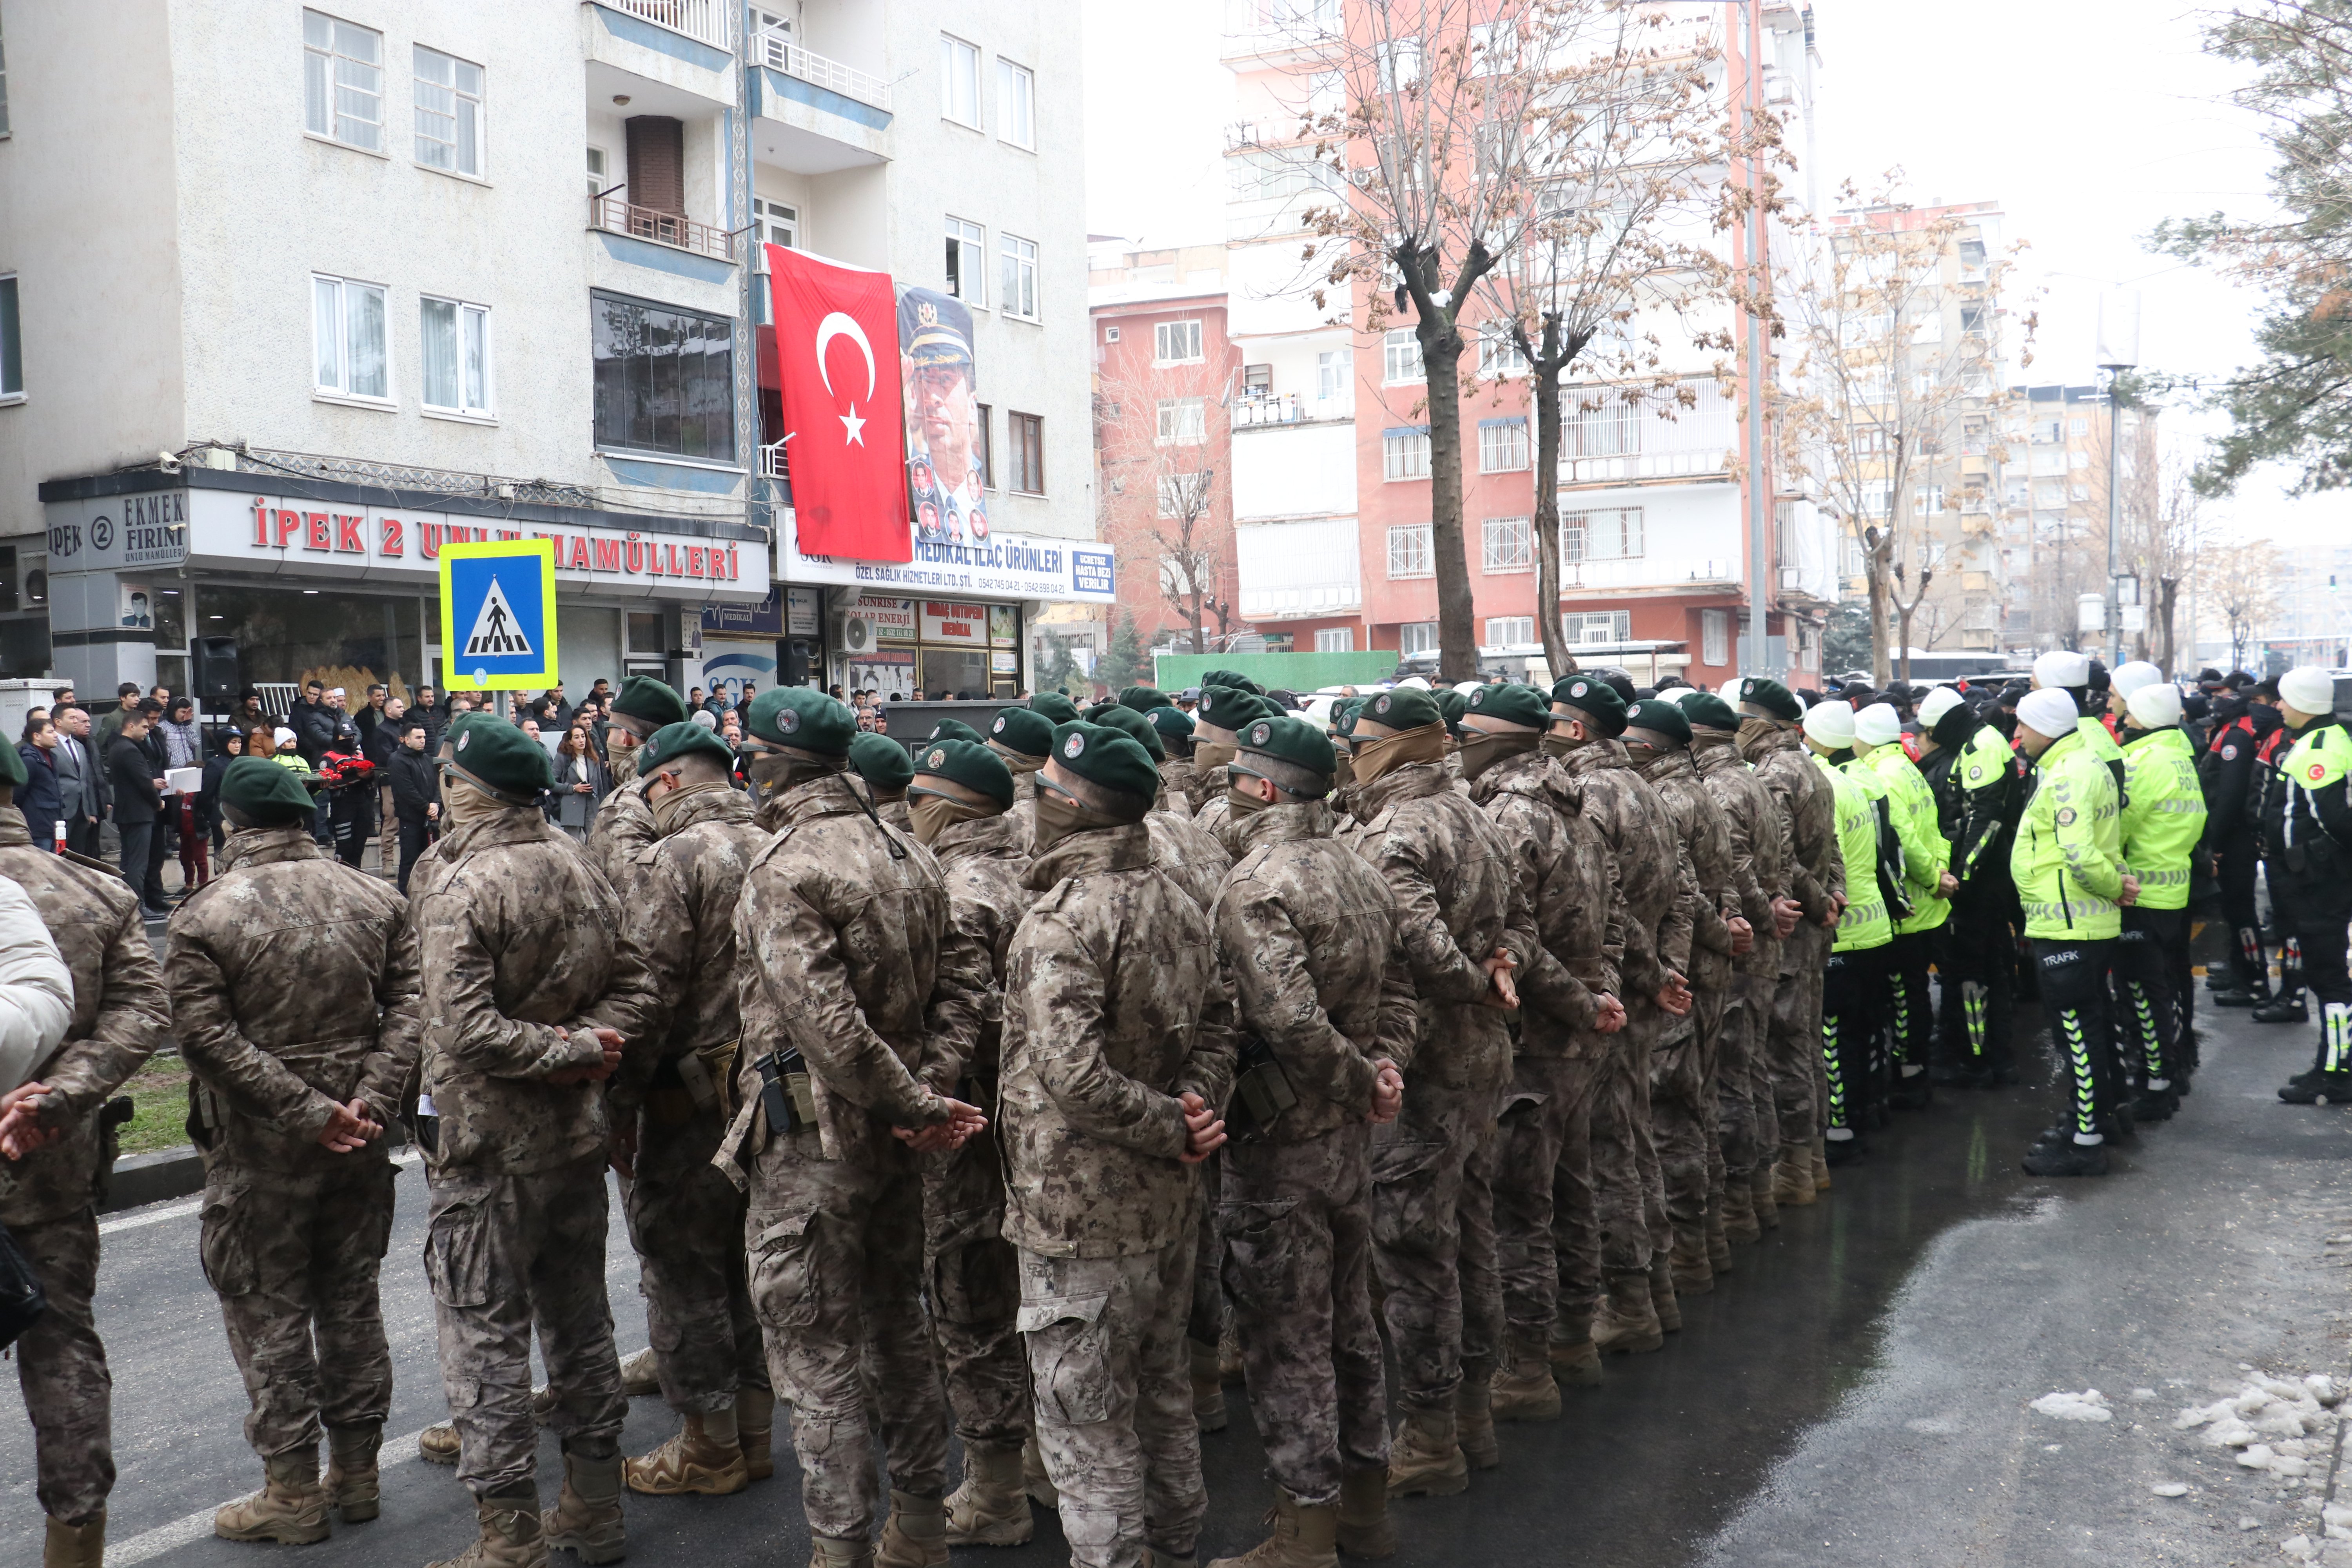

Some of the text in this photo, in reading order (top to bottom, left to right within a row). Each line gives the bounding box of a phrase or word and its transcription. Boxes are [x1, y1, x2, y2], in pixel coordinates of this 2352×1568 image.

[125, 494, 184, 526] EKMEK
[250, 496, 366, 553] İPEK
[379, 517, 403, 558] 2
[48, 523, 108, 557] İPEK 2
[127, 527, 183, 550] FIRINI
[1005, 539, 1063, 573] ÜRÜNLERİ
[1080, 554, 1106, 566] ÜCRETSİZ
[855, 562, 973, 590] ÖZEL SAĞLIK HİZMETLERİ LTD. ŞTİ.
[1075, 564, 1111, 579] HASTA BEZİ
[978, 578, 993, 589] 0542
[994, 579, 1004, 590] 745
[1005, 580, 1013, 590] 04
[1014, 581, 1020, 591] 21
[1024, 582, 1038, 592] 0542
[1039, 583, 1050, 593] 898
[1051, 584, 1058, 593] 04
[1059, 584, 1065, 594] 21
[1078, 577, 1109, 591] VERİLİR
[858, 597, 898, 608] SUNRISE
[724, 612, 750, 621] MEDİKAL
[878, 612, 910, 627] ENERJİ
